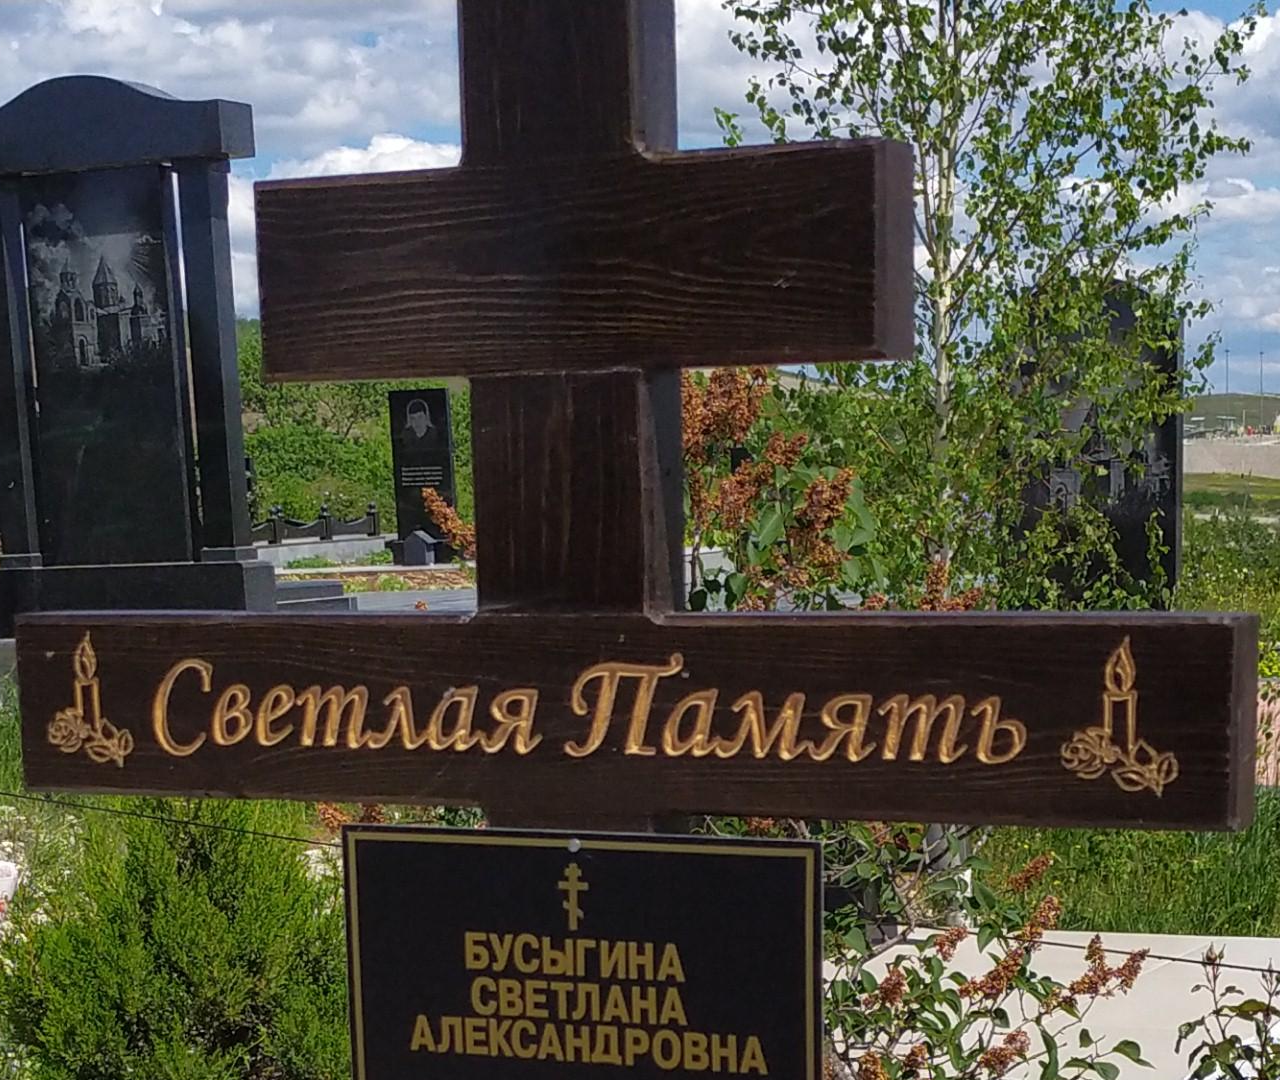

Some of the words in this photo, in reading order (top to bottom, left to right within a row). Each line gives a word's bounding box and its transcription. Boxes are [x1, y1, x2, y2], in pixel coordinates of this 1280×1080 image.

[152, 658, 540, 758] Светлая
[563, 653, 1028, 766] Память
[464, 932, 686, 982] БУСЫГИНА
[471, 977, 688, 1026] СВЕТЛАНА
[410, 1014, 769, 1075] АЛЕКСАНДРОВНА
